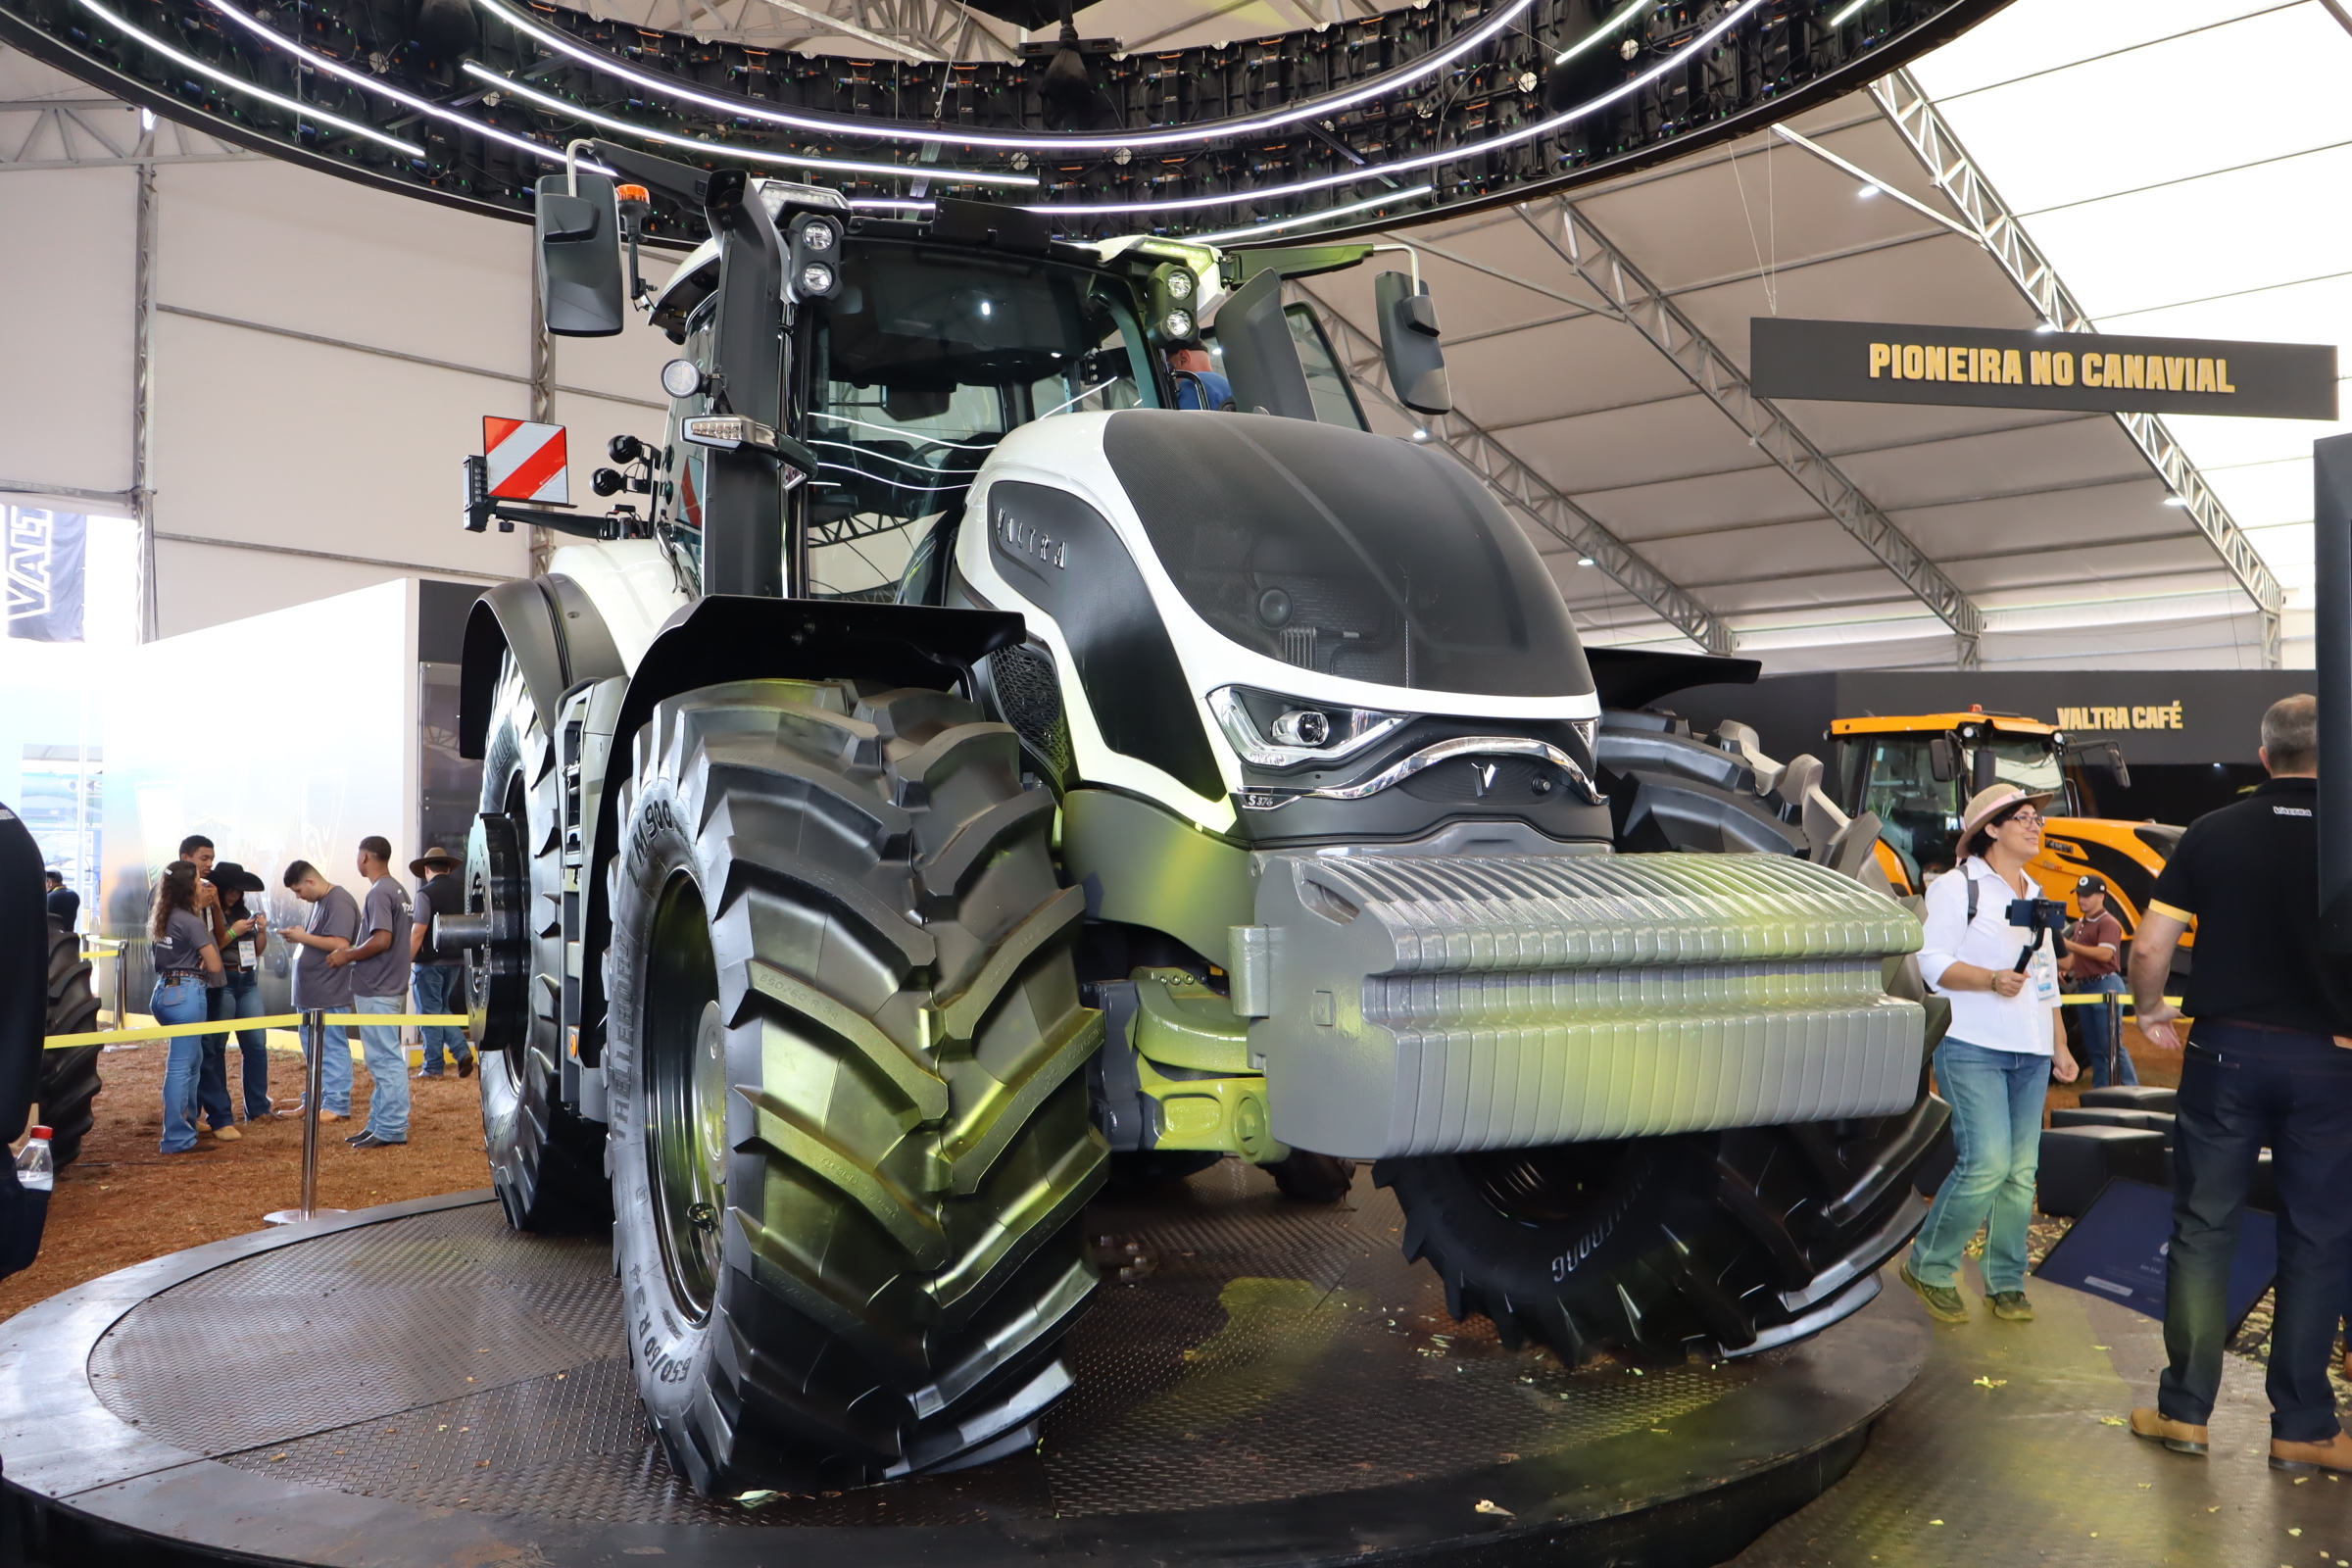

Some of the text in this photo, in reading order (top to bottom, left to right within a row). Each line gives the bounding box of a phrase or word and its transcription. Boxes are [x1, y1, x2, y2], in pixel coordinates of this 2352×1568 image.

[1869, 343, 2236, 393] PIONEIRA NO CANAVIAL
[998, 508, 1066, 569] VALTRA
[2056, 700, 2184, 730] VALTRA CAFÉ
[626, 799, 674, 888] TM 900
[759, 973, 808, 1003] 650/60
[611, 933, 635, 1145] TRELLEBORG
[638, 1310, 653, 1342] R
[643, 1335, 693, 1385] 650/60
